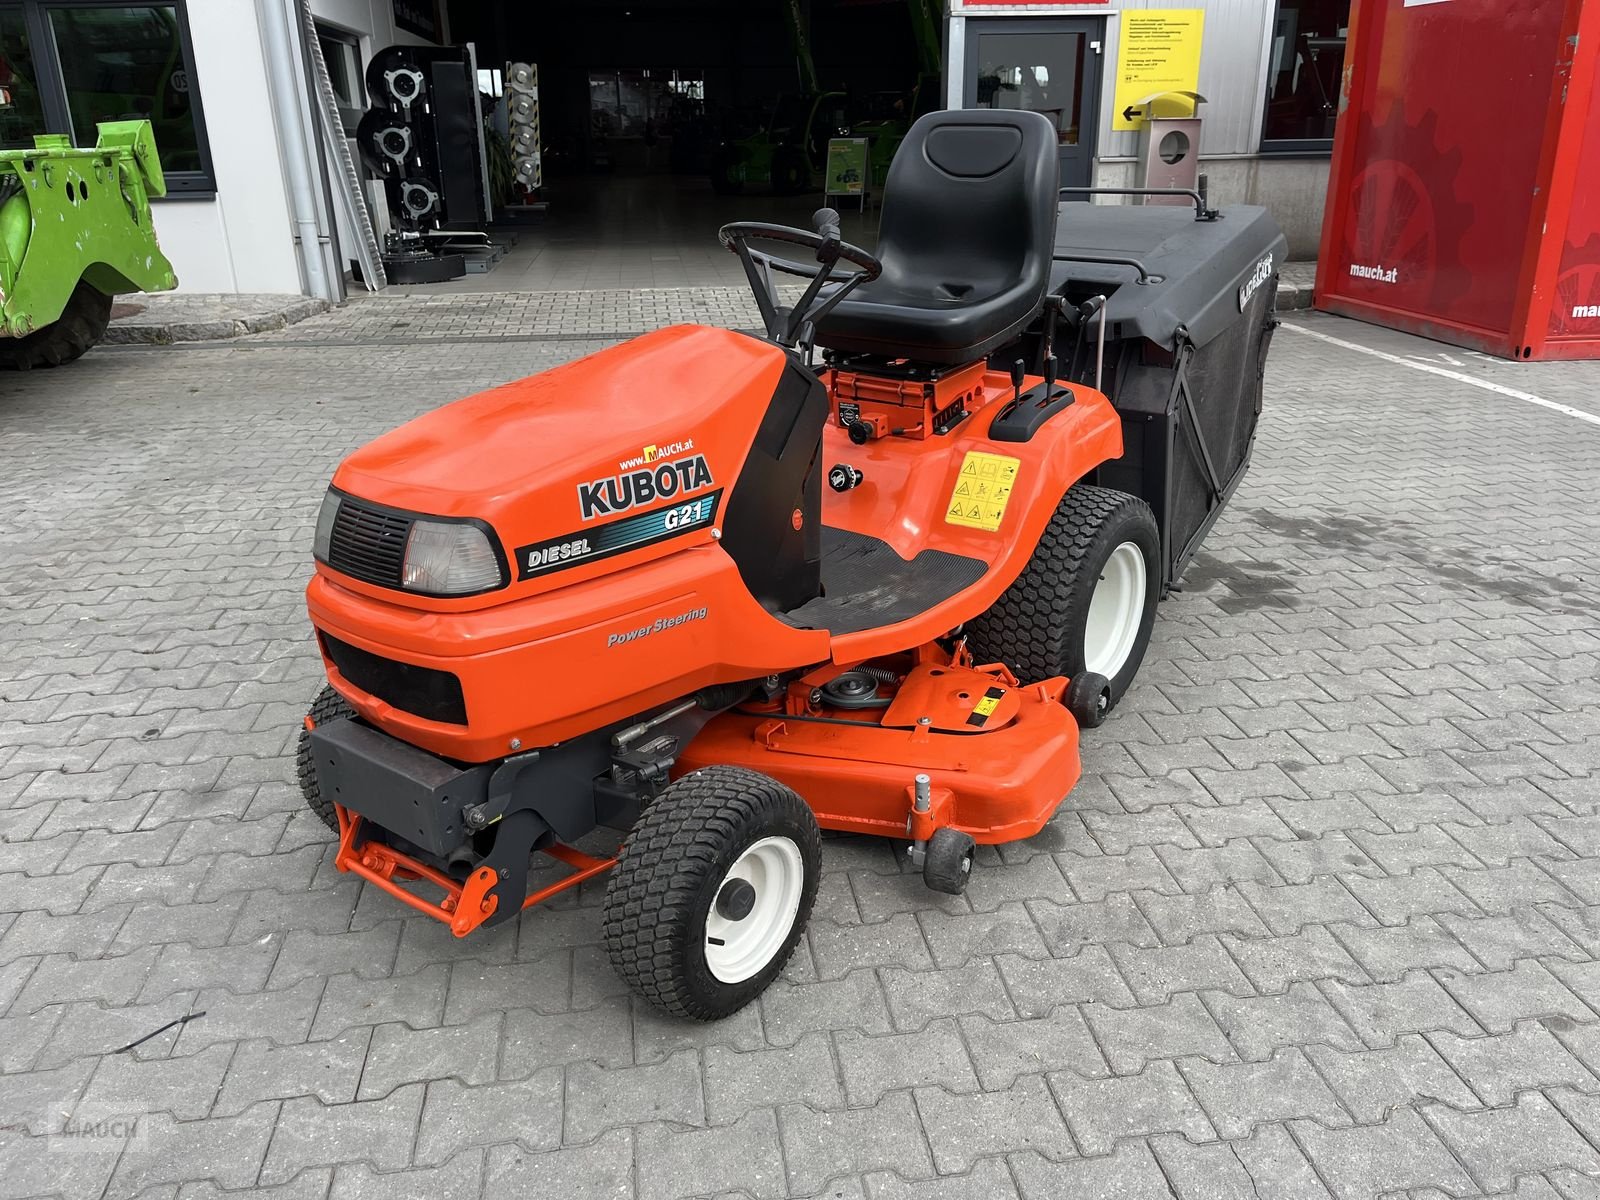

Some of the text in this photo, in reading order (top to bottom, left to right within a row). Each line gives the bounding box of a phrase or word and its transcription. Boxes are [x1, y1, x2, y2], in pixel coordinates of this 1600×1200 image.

[1350, 264, 1398, 284] mauch.at
[1572, 305, 1600, 318] ma
[619, 439, 694, 471] www.MAUCH.at
[578, 454, 713, 521] KUBOTA
[664, 501, 702, 530] G21
[528, 538, 592, 568] DIESEL
[608, 607, 708, 648] Power Steering
